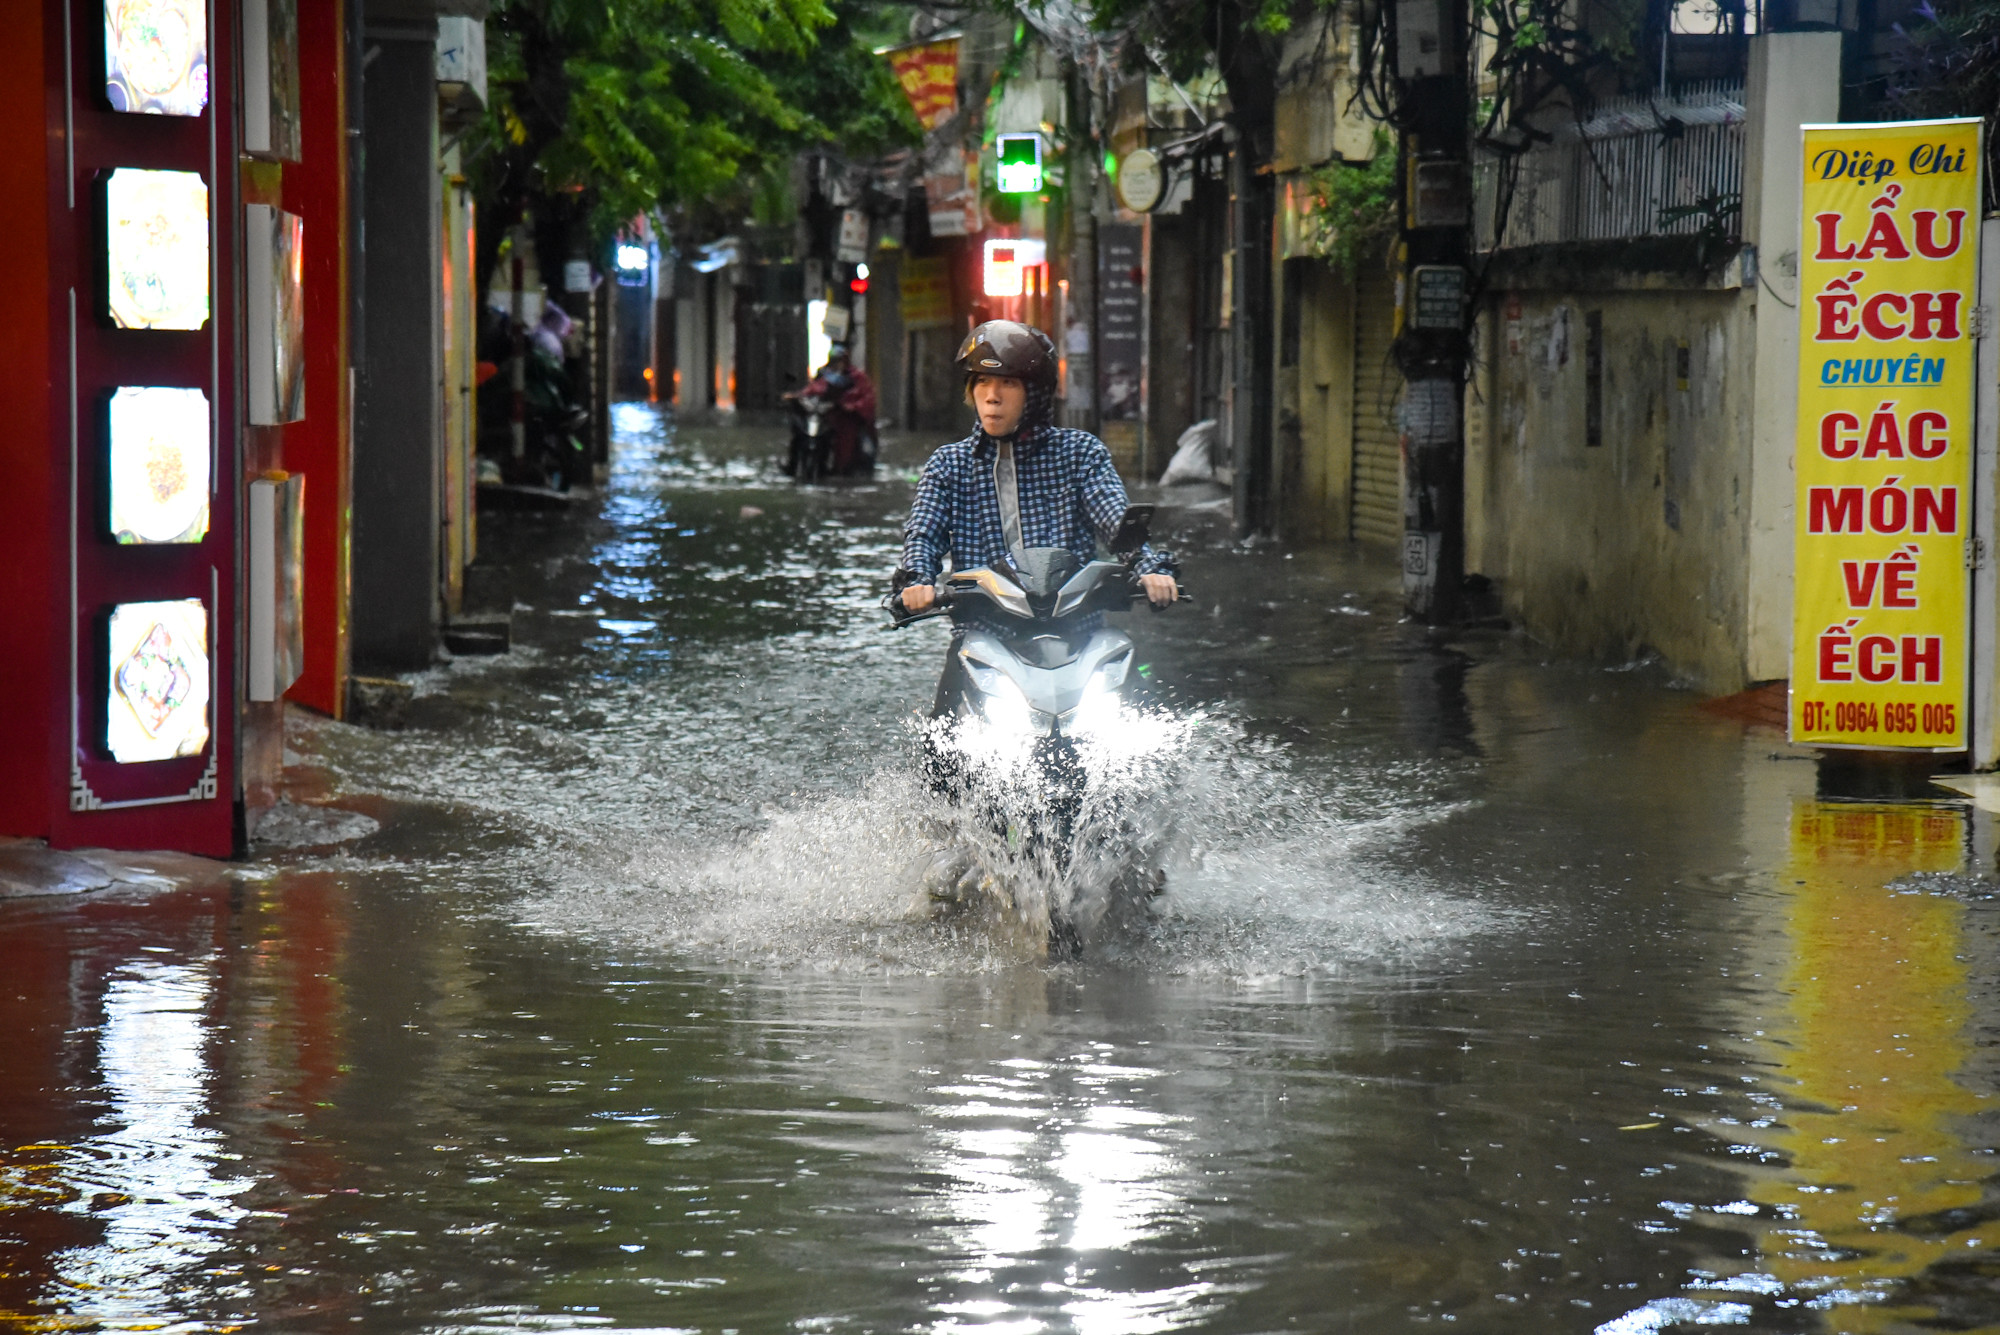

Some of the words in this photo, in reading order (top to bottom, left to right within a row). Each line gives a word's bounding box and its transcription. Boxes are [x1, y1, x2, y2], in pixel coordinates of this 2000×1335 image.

[1812, 149, 1897, 186] Diệp
[1909, 144, 1967, 175] Chi
[1815, 184, 1966, 260] LẨU
[1815, 271, 1961, 340] ẾCH
[1821, 353, 1945, 384] CHUYÊN
[1822, 403, 1947, 459] CÁC
[1809, 478, 1957, 533] MÓN
[1843, 545, 1920, 607] VỀ
[1819, 619, 1940, 682] ẾCH
[1803, 701, 1829, 731] ĐT:
[1836, 702, 1878, 732] 0964
[1884, 703, 1917, 733] 695
[1922, 703, 1955, 734] 005
